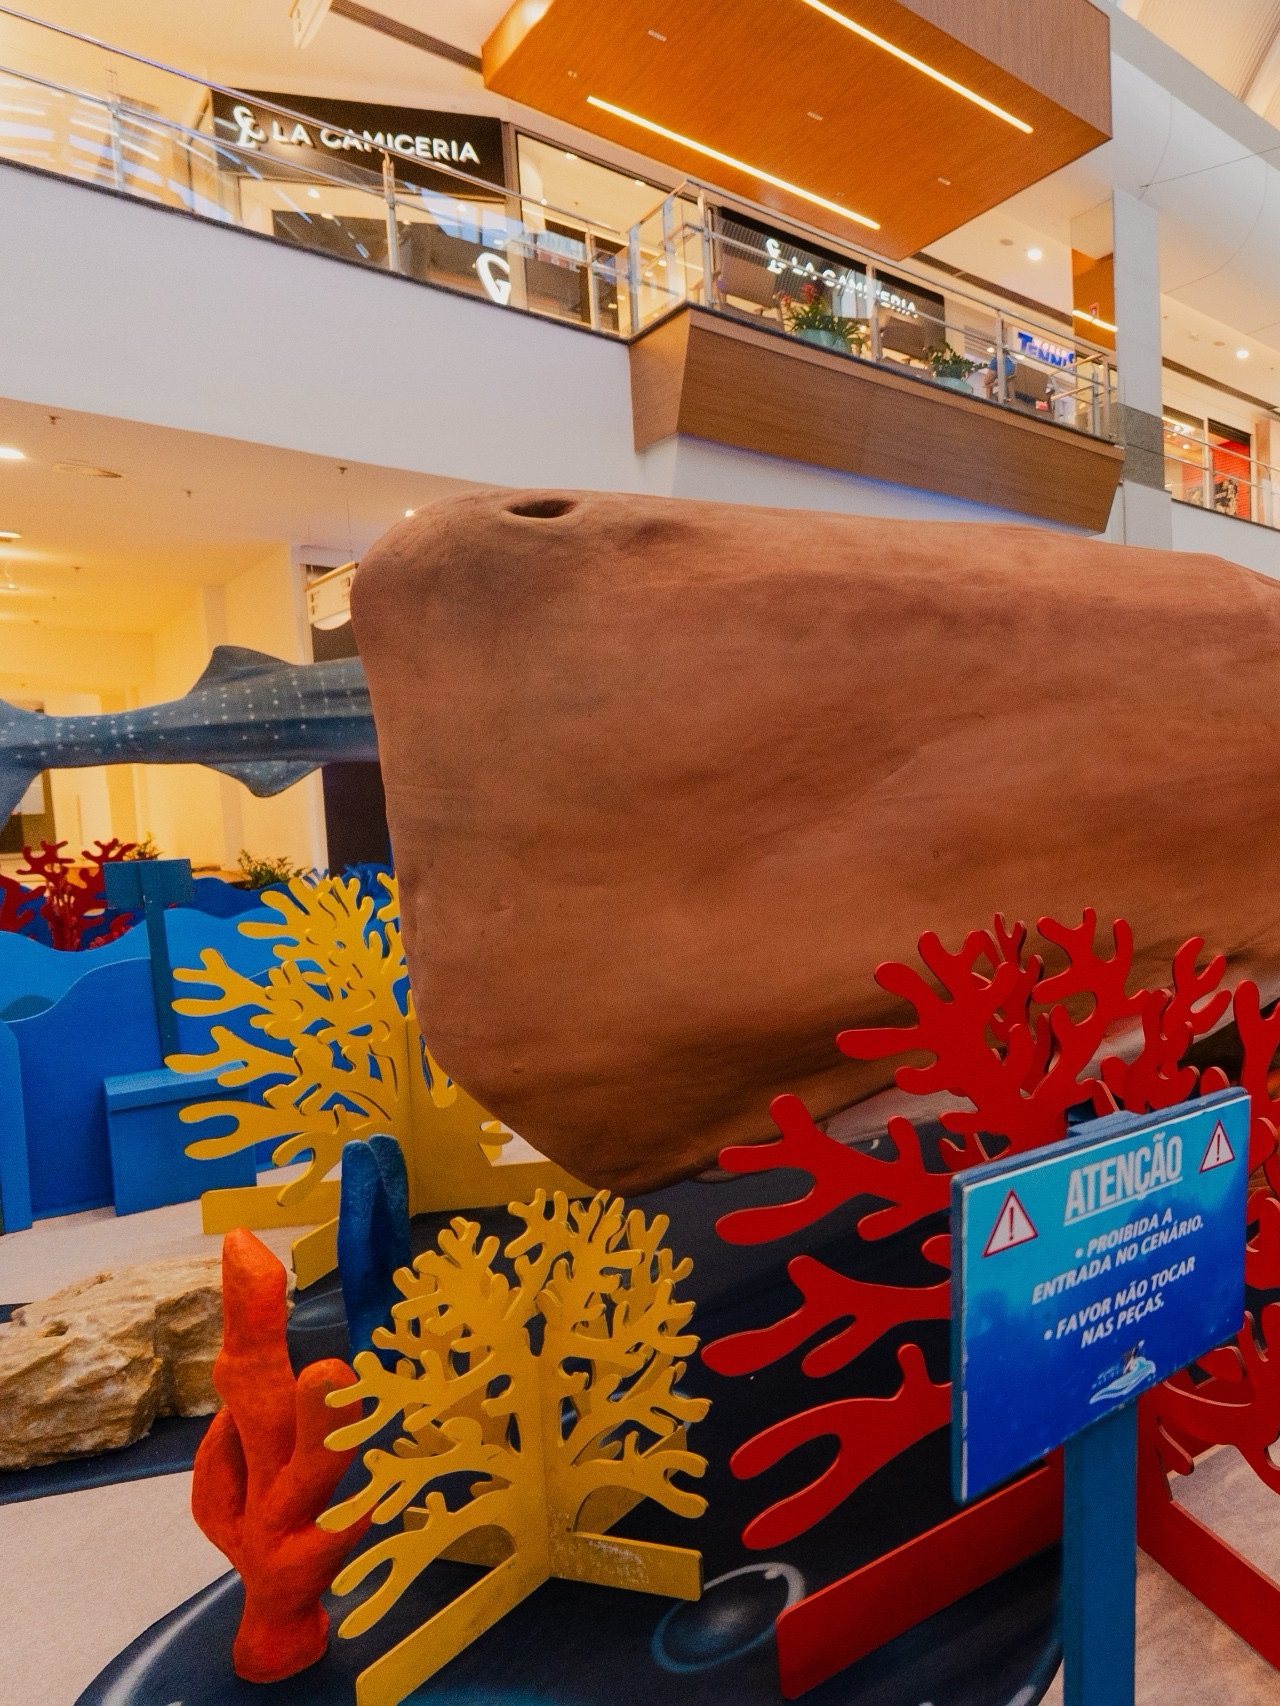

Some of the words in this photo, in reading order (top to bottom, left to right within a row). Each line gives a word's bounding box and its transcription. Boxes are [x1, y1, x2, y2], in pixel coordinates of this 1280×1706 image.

[272, 120, 314, 147] LA
[320, 128, 481, 164] CAMICERIA
[1064, 1131, 1183, 1222] ATENÇÃO
[1032, 1254, 1112, 1305] ENTRADA
[1115, 1243, 1138, 1267] NO
[1141, 1214, 1203, 1255] CENÁRIO.
[1087, 1213, 1159, 1258] PROIBIDA
[1161, 1207, 1173, 1225] A
[1056, 1297, 1112, 1340] FAVOR
[1114, 1280, 1148, 1310] NÃO
[1151, 1256, 1196, 1292] TOCAR
[1081, 1317, 1114, 1349] NAS
[1116, 1292, 1165, 1330] PEÇAS.
